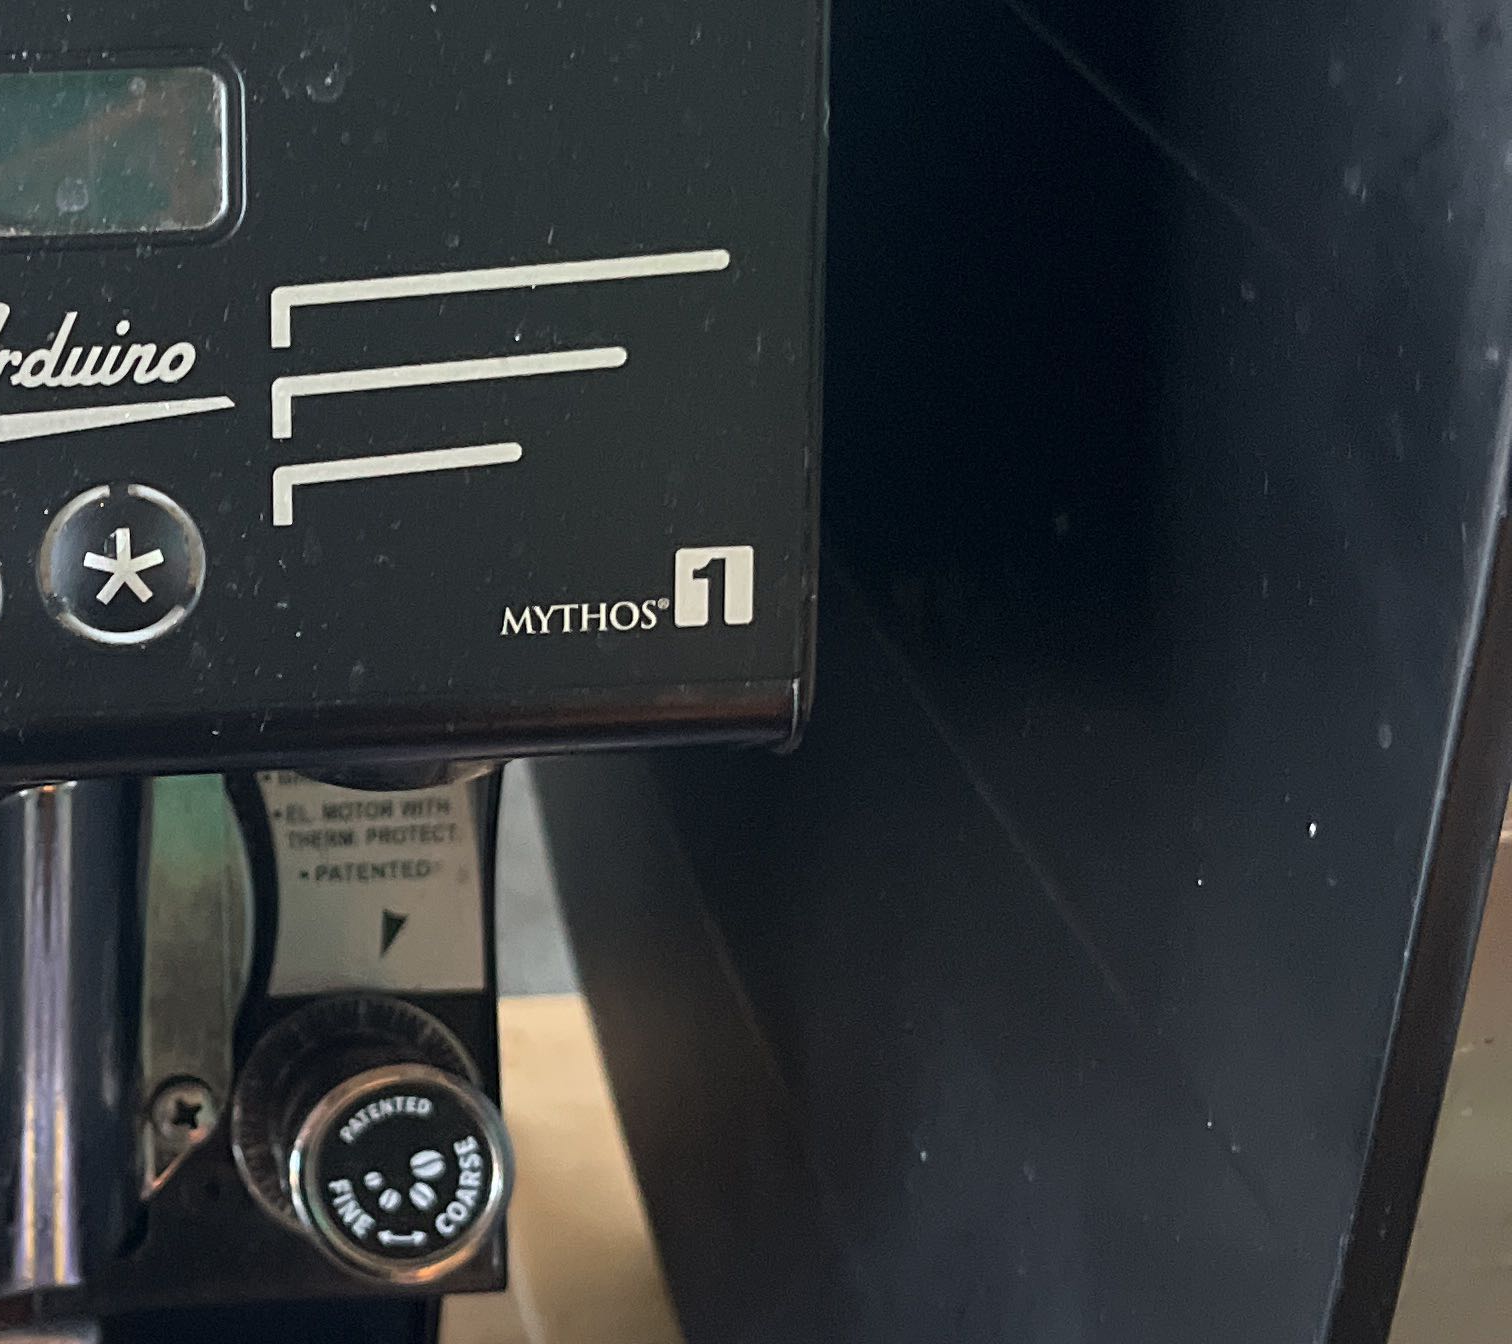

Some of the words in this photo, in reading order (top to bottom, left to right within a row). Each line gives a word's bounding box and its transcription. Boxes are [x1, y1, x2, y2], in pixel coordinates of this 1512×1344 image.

[321, 799, 394, 821] MOTOR
[399, 797, 451, 817] WITH
[314, 859, 432, 881] PATENTED
[339, 1096, 433, 1144] PATENTED
[328, 1178, 376, 1240] FINE
[434, 1135, 484, 1237] COARSE
